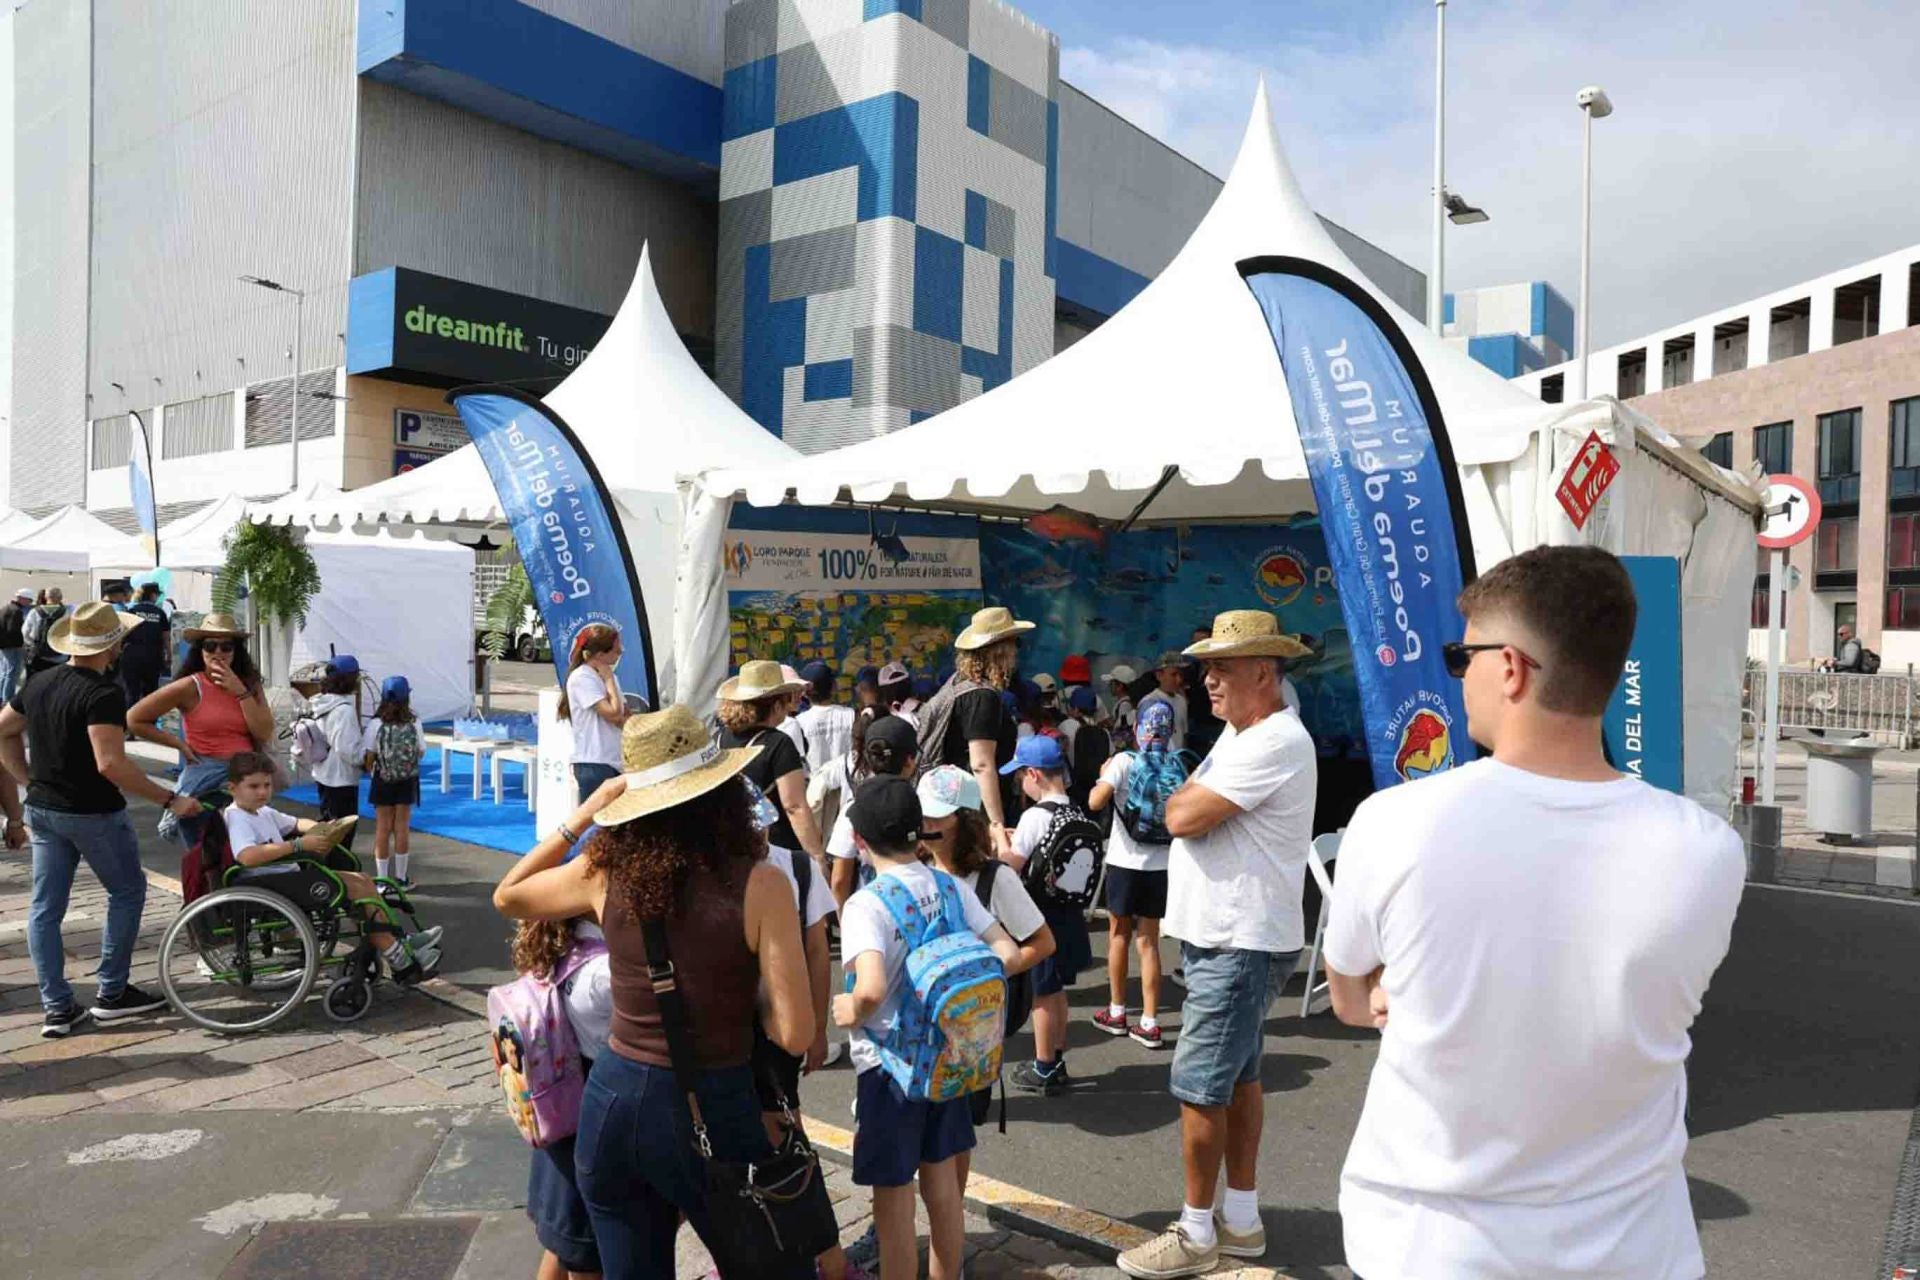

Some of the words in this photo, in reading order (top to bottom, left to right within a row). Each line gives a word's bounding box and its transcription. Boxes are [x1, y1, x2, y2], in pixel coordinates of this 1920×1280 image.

[537, 335, 558, 359] Tu
[400, 412, 422, 442] P
[753, 546, 777, 558] LORO
[818, 548, 877, 580] 100%
[1624, 659, 1641, 706] MAR
[1625, 713, 1642, 752] DEL
